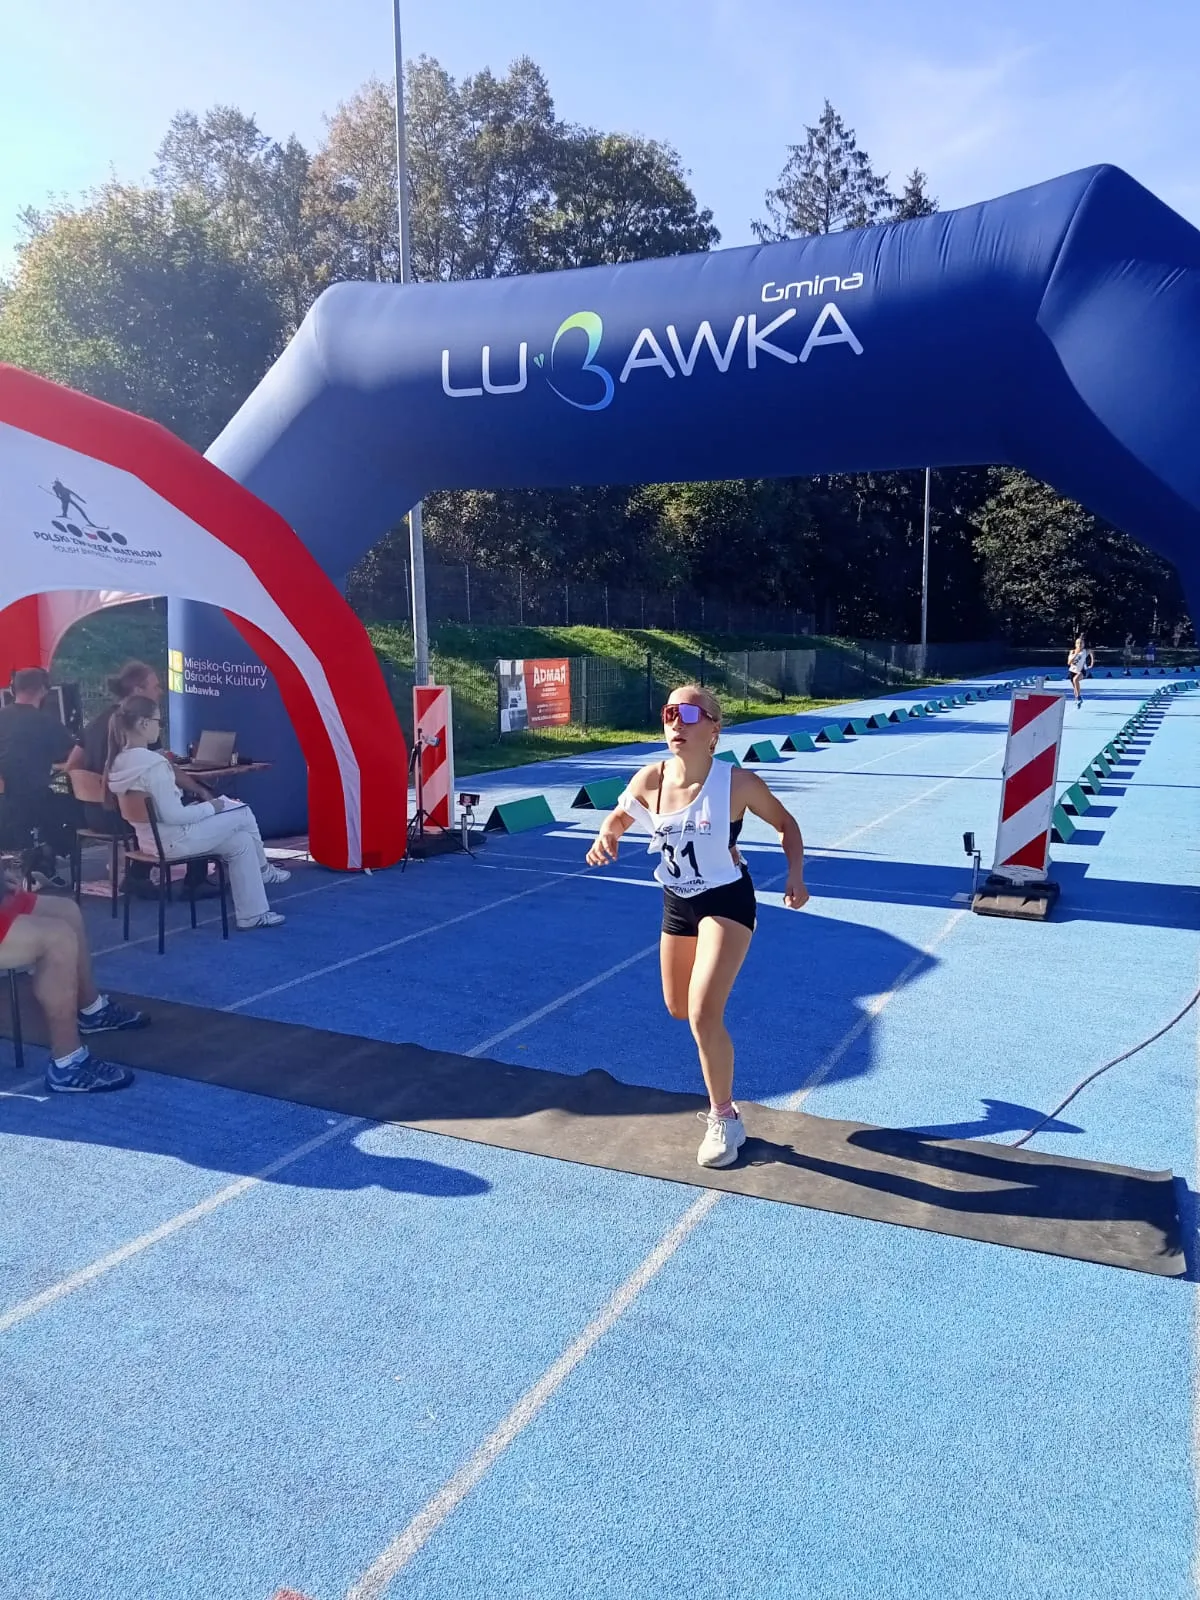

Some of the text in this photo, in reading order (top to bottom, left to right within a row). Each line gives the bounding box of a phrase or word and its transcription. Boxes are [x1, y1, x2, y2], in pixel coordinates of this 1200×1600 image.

[761, 271, 864, 303] Gmina
[441, 302, 864, 412] LUBAWKA
[184, 657, 267, 676] Miejsko-Gminny
[184, 669, 267, 688] Ośrodek Kultury
[184, 684, 220, 696] Lubawka
